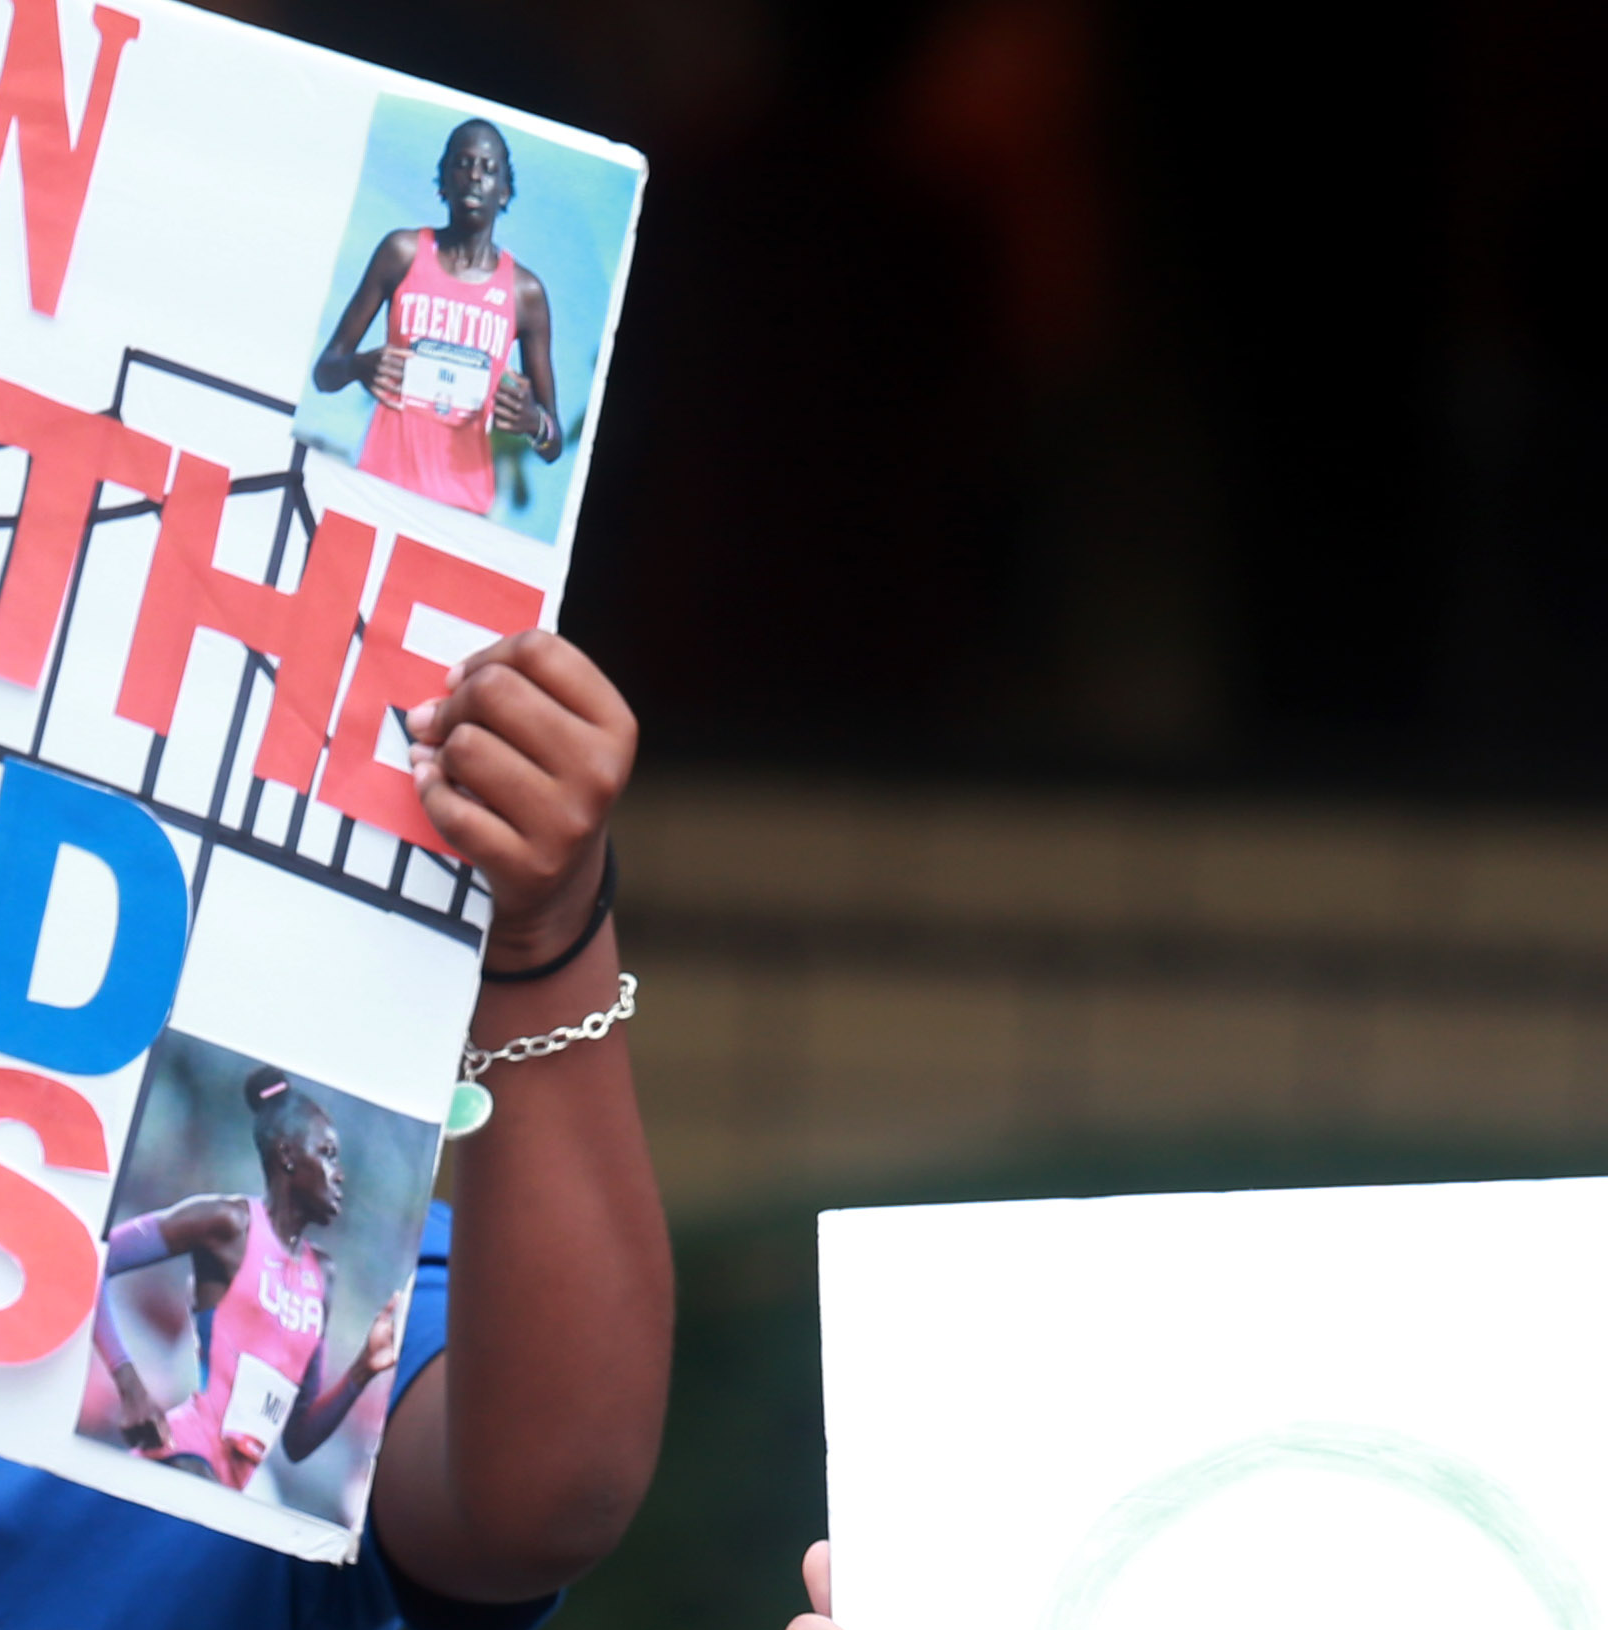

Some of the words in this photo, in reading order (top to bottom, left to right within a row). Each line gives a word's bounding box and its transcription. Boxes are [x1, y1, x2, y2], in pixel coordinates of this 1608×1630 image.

[400, 293, 508, 359] TRENTON
[258, 1270, 324, 1339] USA
[261, 1392, 283, 1425] MU
